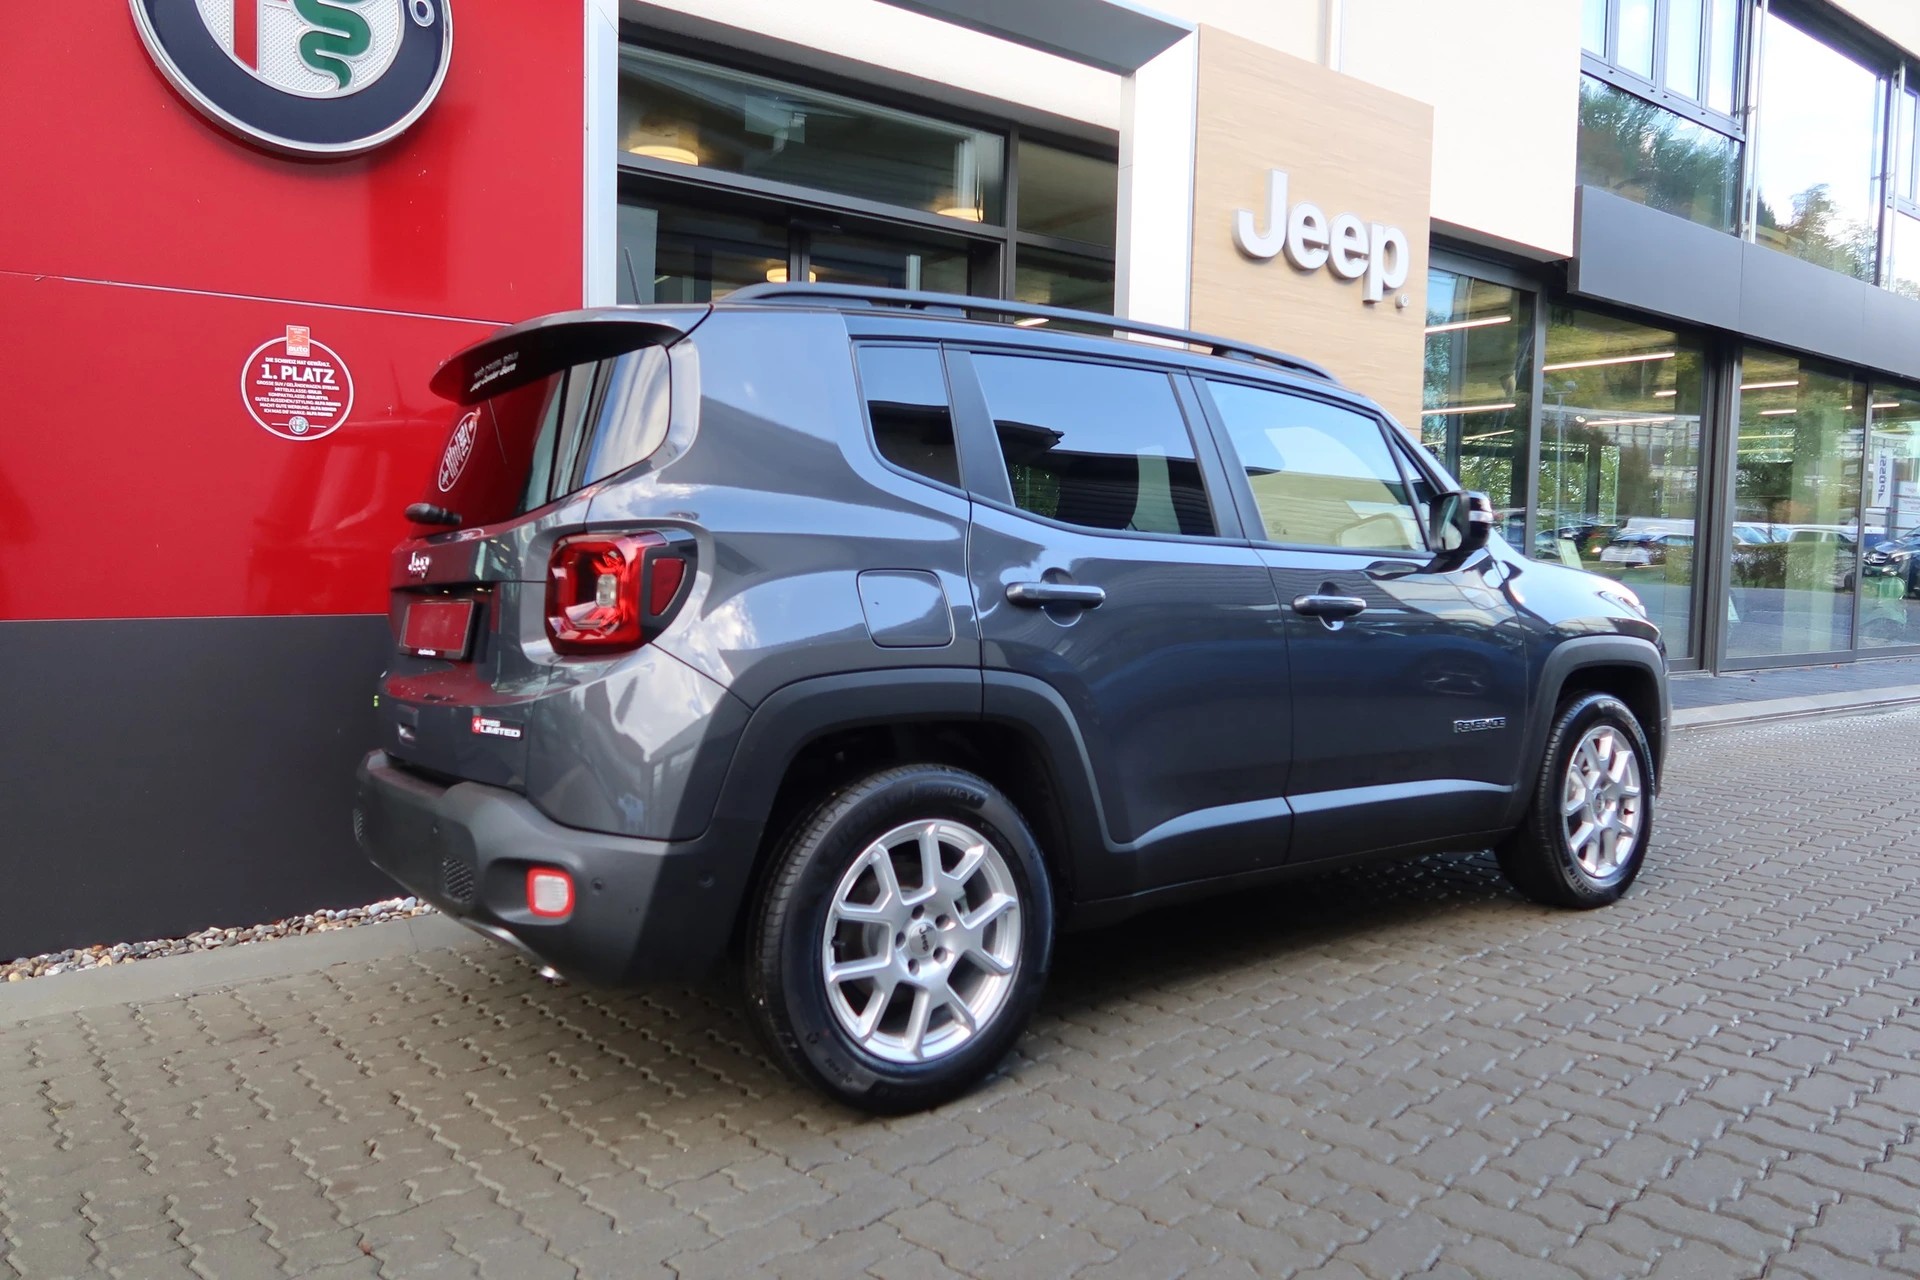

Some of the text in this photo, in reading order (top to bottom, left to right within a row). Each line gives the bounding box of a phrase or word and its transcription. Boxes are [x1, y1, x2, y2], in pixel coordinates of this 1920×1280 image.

[1232, 168, 1409, 303] Jeep
[261, 363, 334, 383] 1. PLATZ
[480, 726, 521, 737] LIMITED
[919, 925, 934, 951] Jeep
